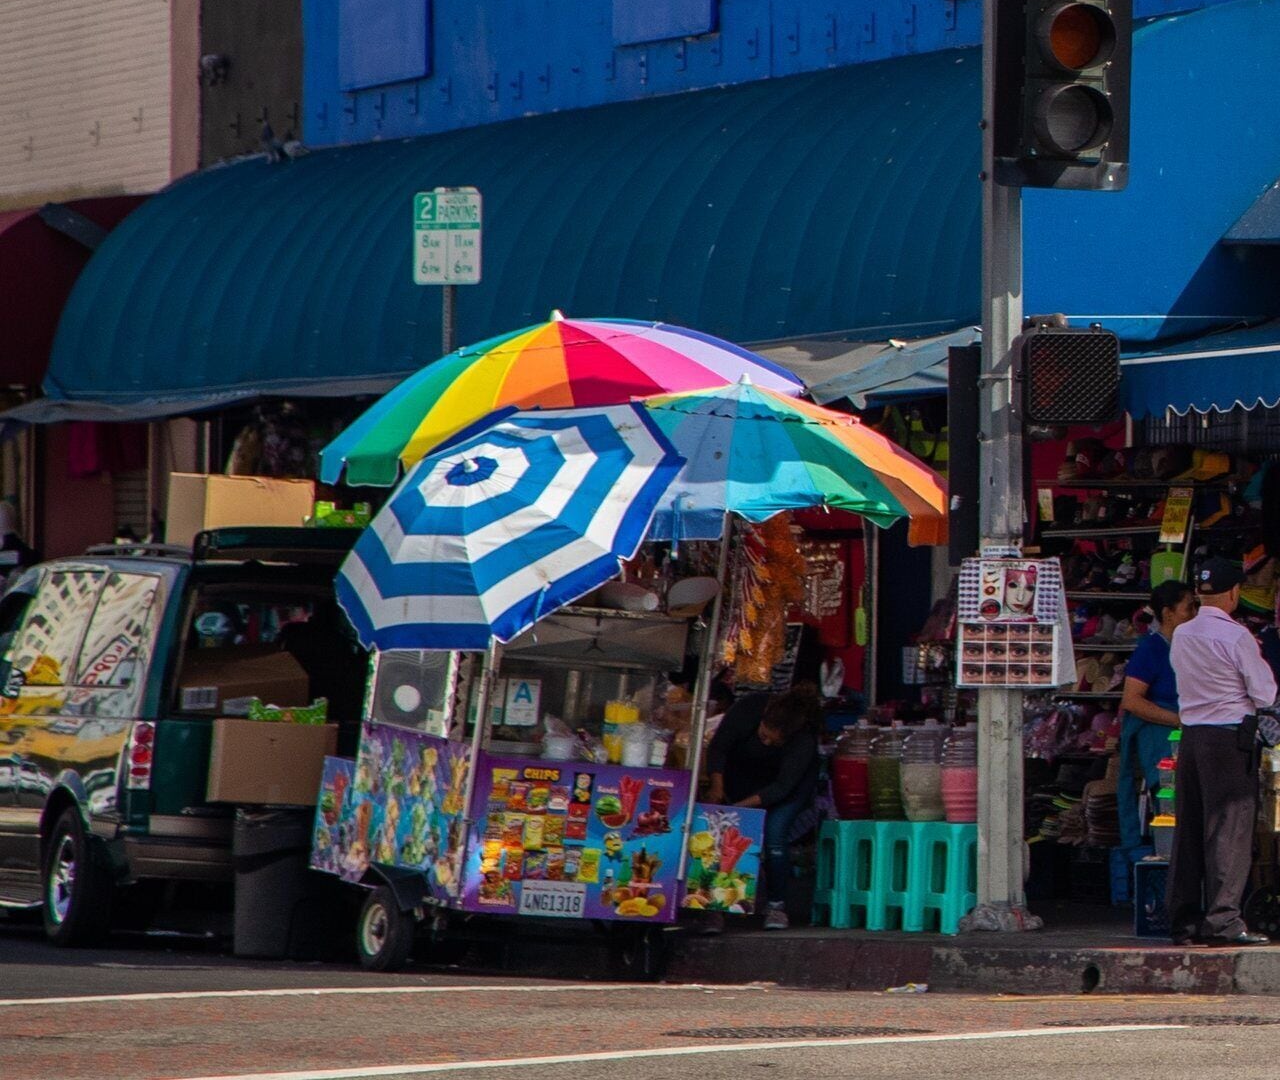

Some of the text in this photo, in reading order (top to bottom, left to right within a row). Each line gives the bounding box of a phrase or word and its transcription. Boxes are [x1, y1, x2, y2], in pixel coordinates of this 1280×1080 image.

[420, 197, 433, 219] 2
[438, 204, 478, 221] PARKING
[513, 681, 533, 704] A
[523, 767, 560, 781] CHIPS
